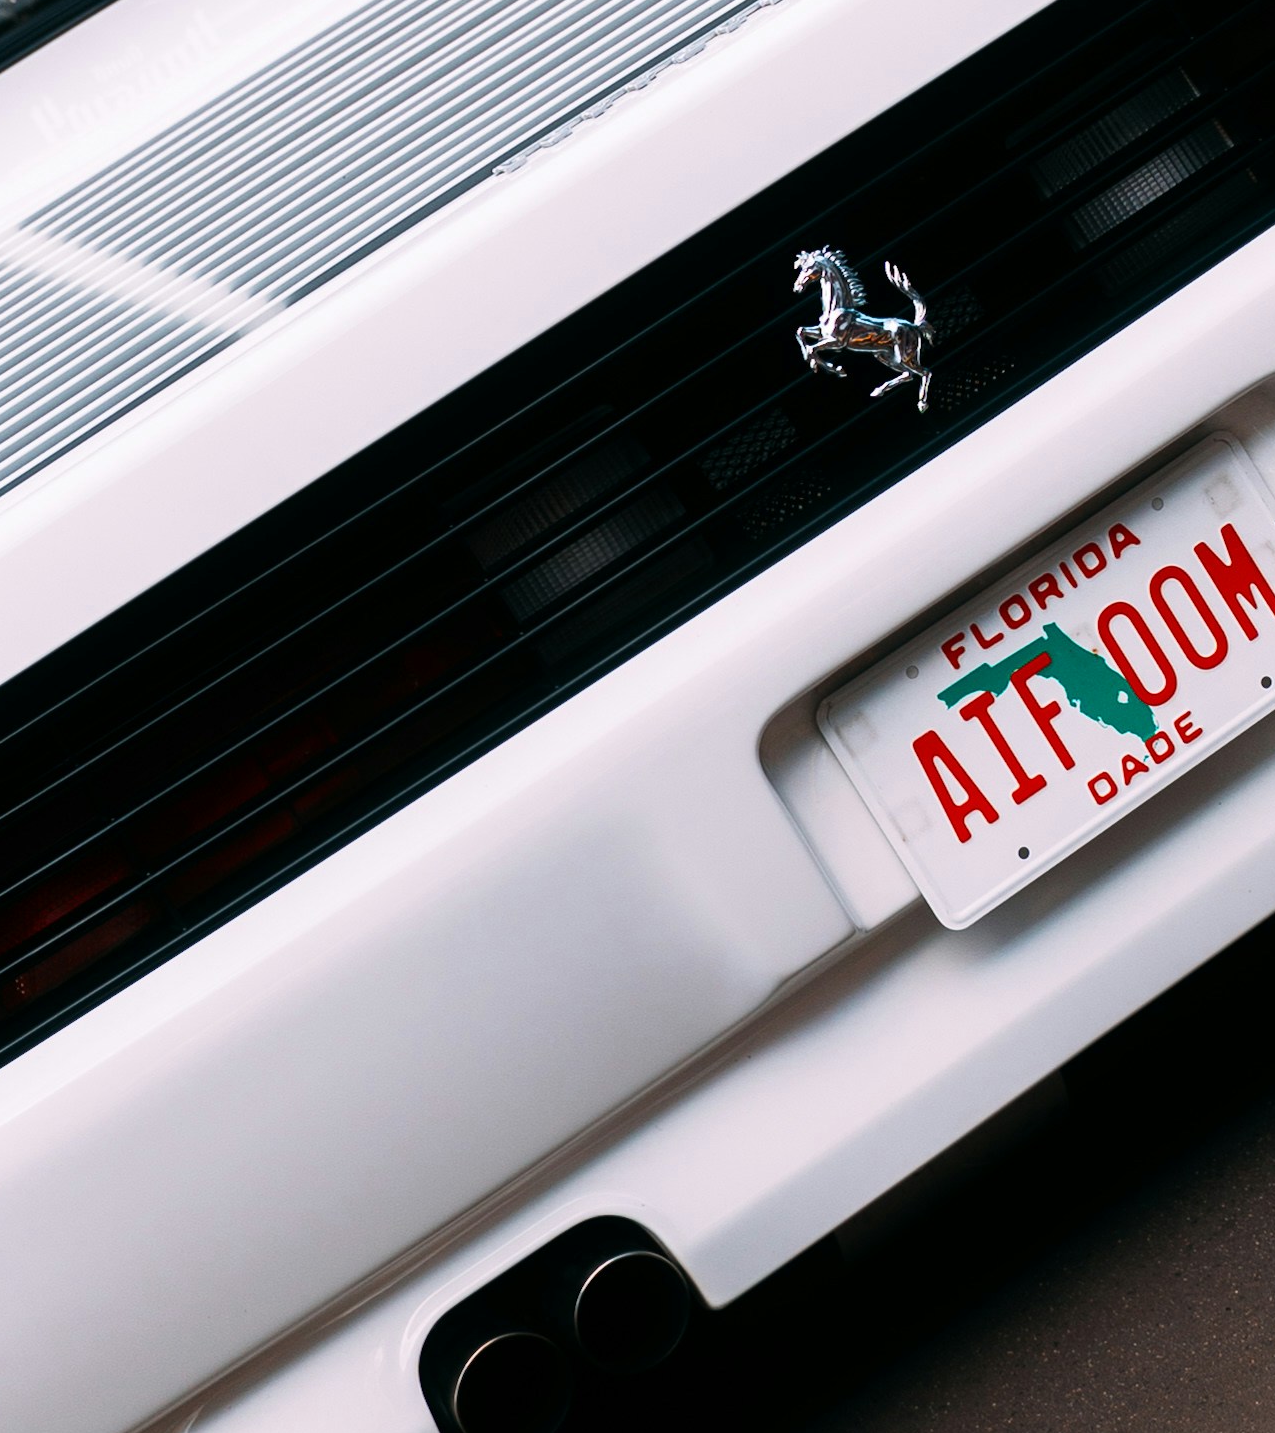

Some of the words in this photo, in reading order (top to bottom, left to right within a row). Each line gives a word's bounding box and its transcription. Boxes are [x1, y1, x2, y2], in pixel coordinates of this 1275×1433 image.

[940, 522, 1142, 670] FLORIDA
[912, 651, 1076, 845] AIF
[1086, 710, 1204, 807] DADE
